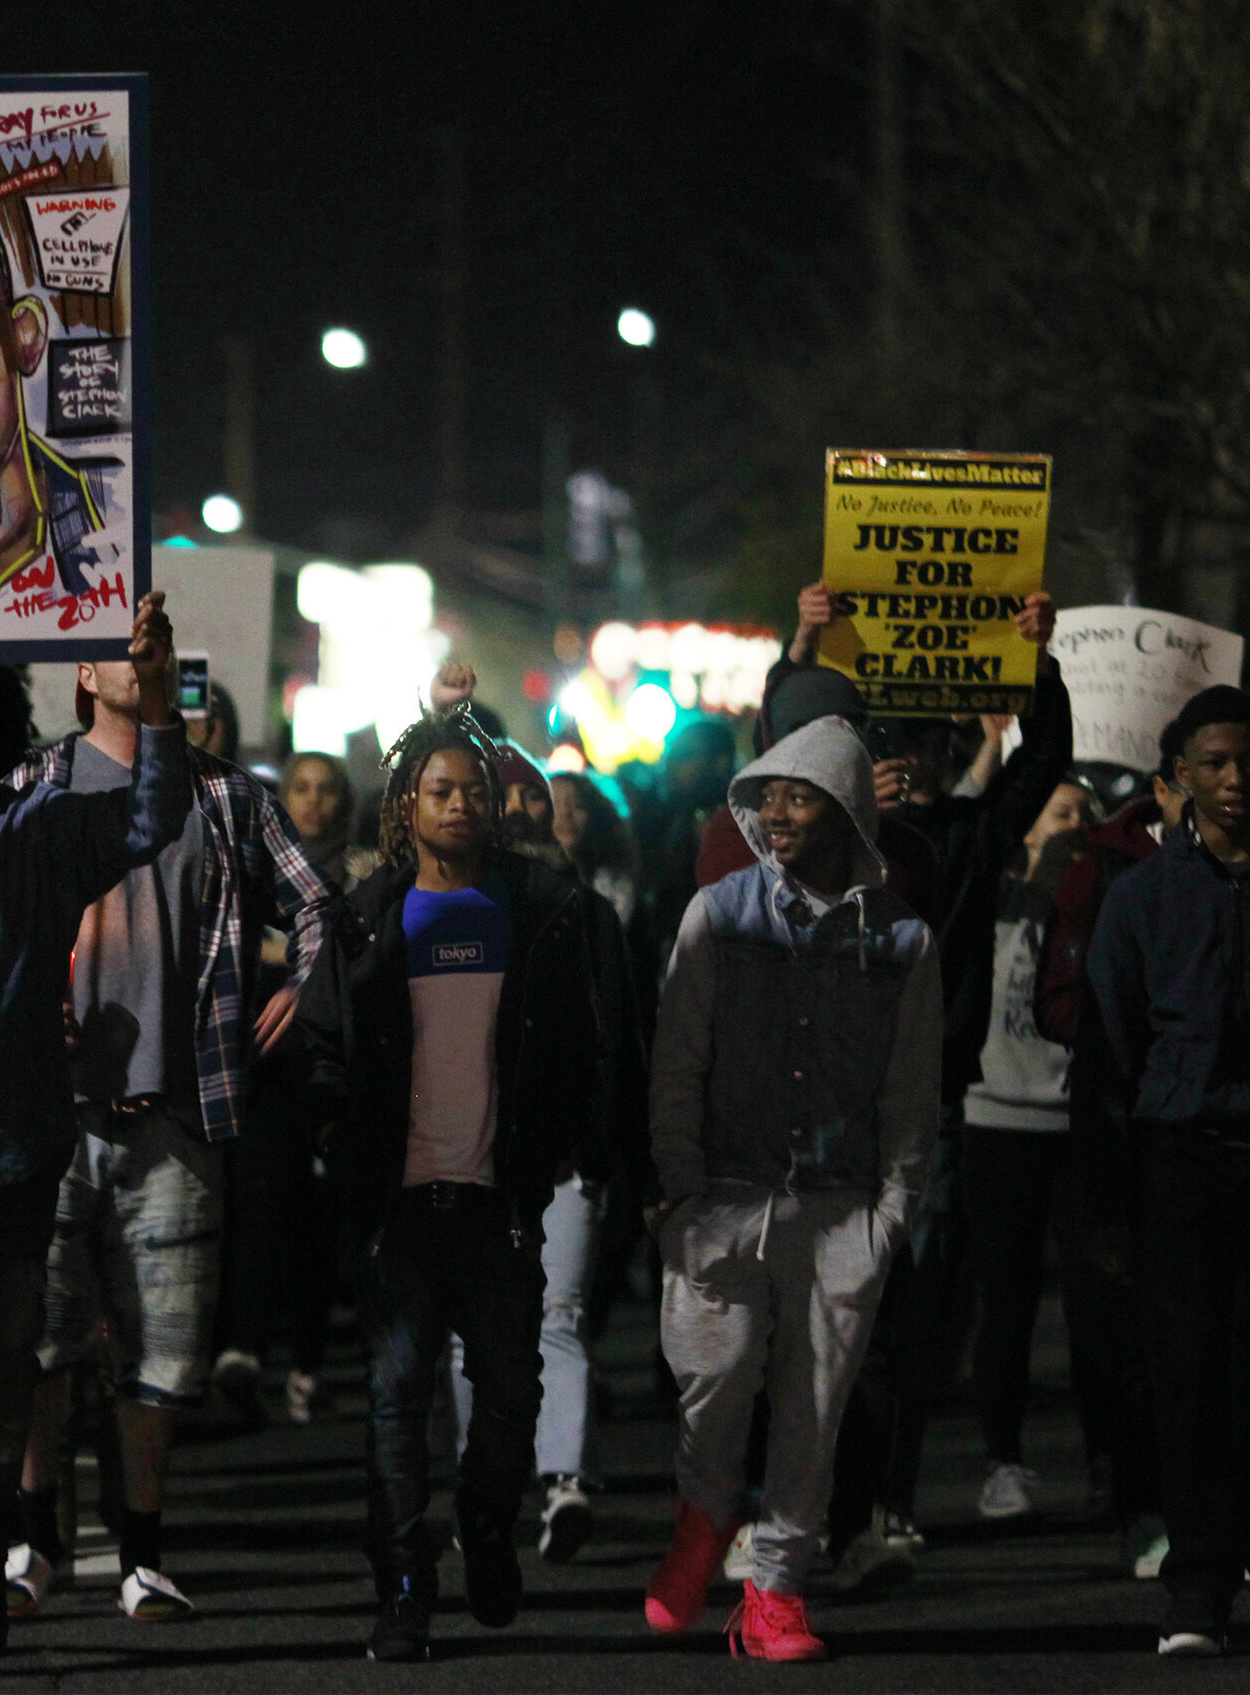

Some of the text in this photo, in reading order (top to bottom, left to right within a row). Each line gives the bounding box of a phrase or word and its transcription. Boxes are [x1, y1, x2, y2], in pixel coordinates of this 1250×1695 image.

[74, 102, 97, 116] US
[36, 198, 116, 215] WARNING
[50, 255, 101, 268] IN USE
[66, 273, 103, 288] GUNS
[68, 345, 112, 361] THE
[59, 361, 119, 383] STORY
[837, 460, 1044, 484] #BlackLivesMatter
[836, 494, 1043, 518] No Justice, No Peace!
[854, 524, 1019, 554] JUSTICE
[11, 556, 55, 592] ON
[895, 560, 973, 588] FOR
[5, 572, 127, 631] THE 20TH
[837, 591, 1027, 621] STEPHON
[854, 653, 1002, 681] CLARK!
[439, 946, 477, 961] tokyo
